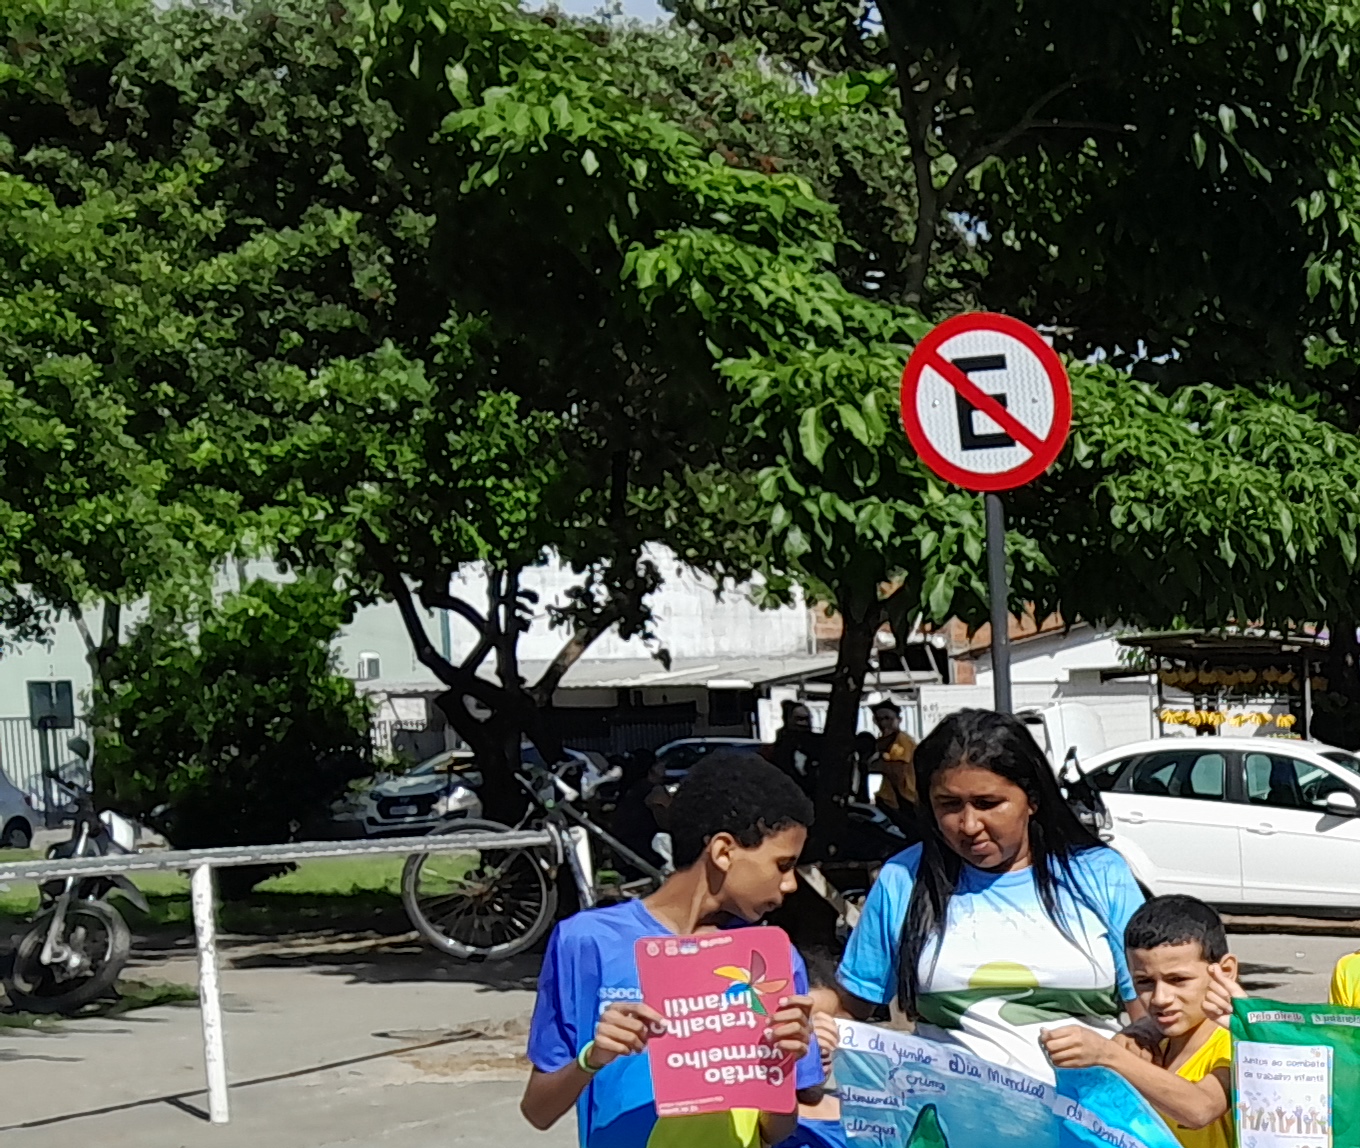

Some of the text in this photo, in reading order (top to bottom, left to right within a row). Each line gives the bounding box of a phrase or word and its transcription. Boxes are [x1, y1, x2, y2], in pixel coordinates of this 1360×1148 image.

[951, 354, 1016, 451] E
[664, 991, 753, 1018] infantil
[667, 1044, 784, 1069] vermelho
[704, 1065, 784, 1087] Cartão
[988, 1067, 1045, 1100] Mundial
